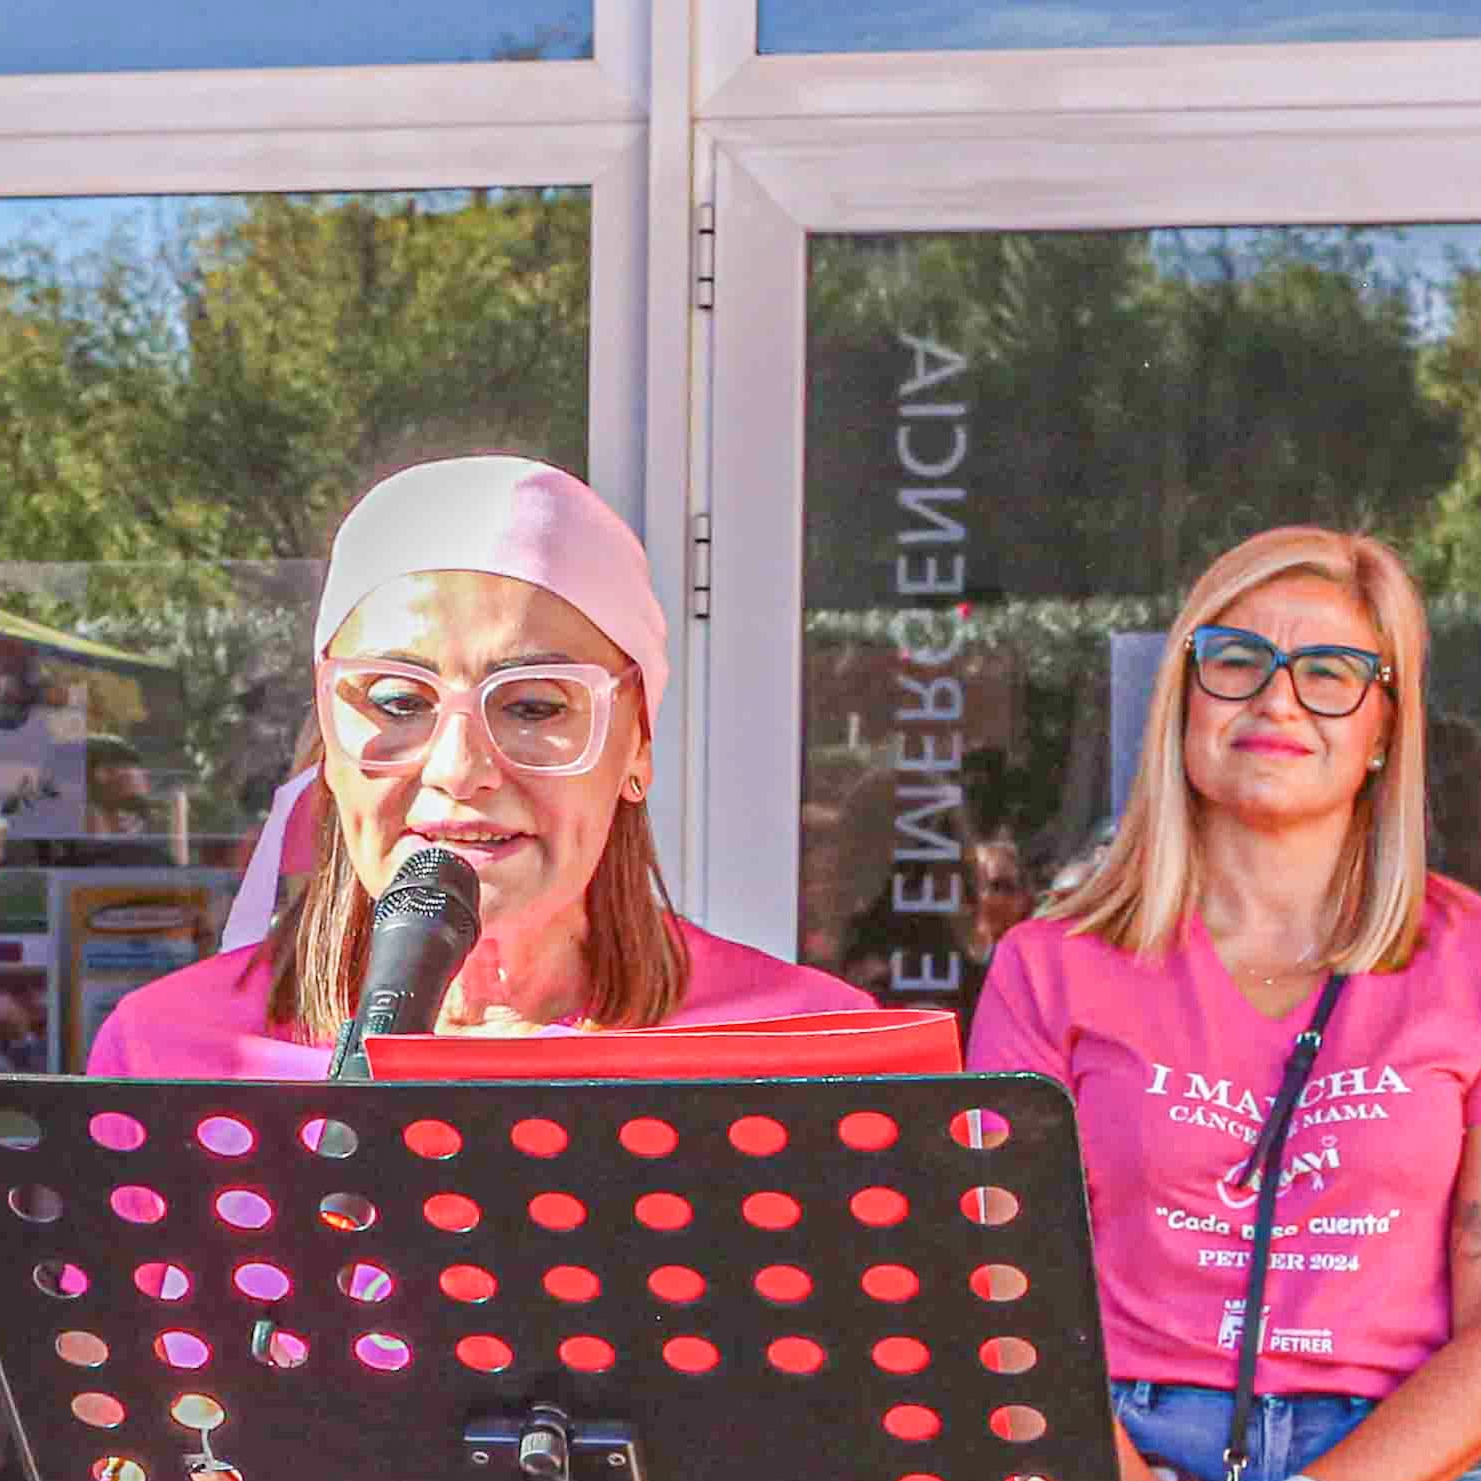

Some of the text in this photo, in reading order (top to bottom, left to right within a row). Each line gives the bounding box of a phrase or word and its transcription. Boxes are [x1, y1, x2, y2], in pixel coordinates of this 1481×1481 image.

[1145, 1063, 1412, 1123] I MACHA
[1169, 1103, 1258, 1145] CÁNCE
[1302, 1101, 1389, 1128] MAMA
[1198, 1249, 1361, 1272] PETER 2024
[1270, 1335, 1333, 1353] PETRER
